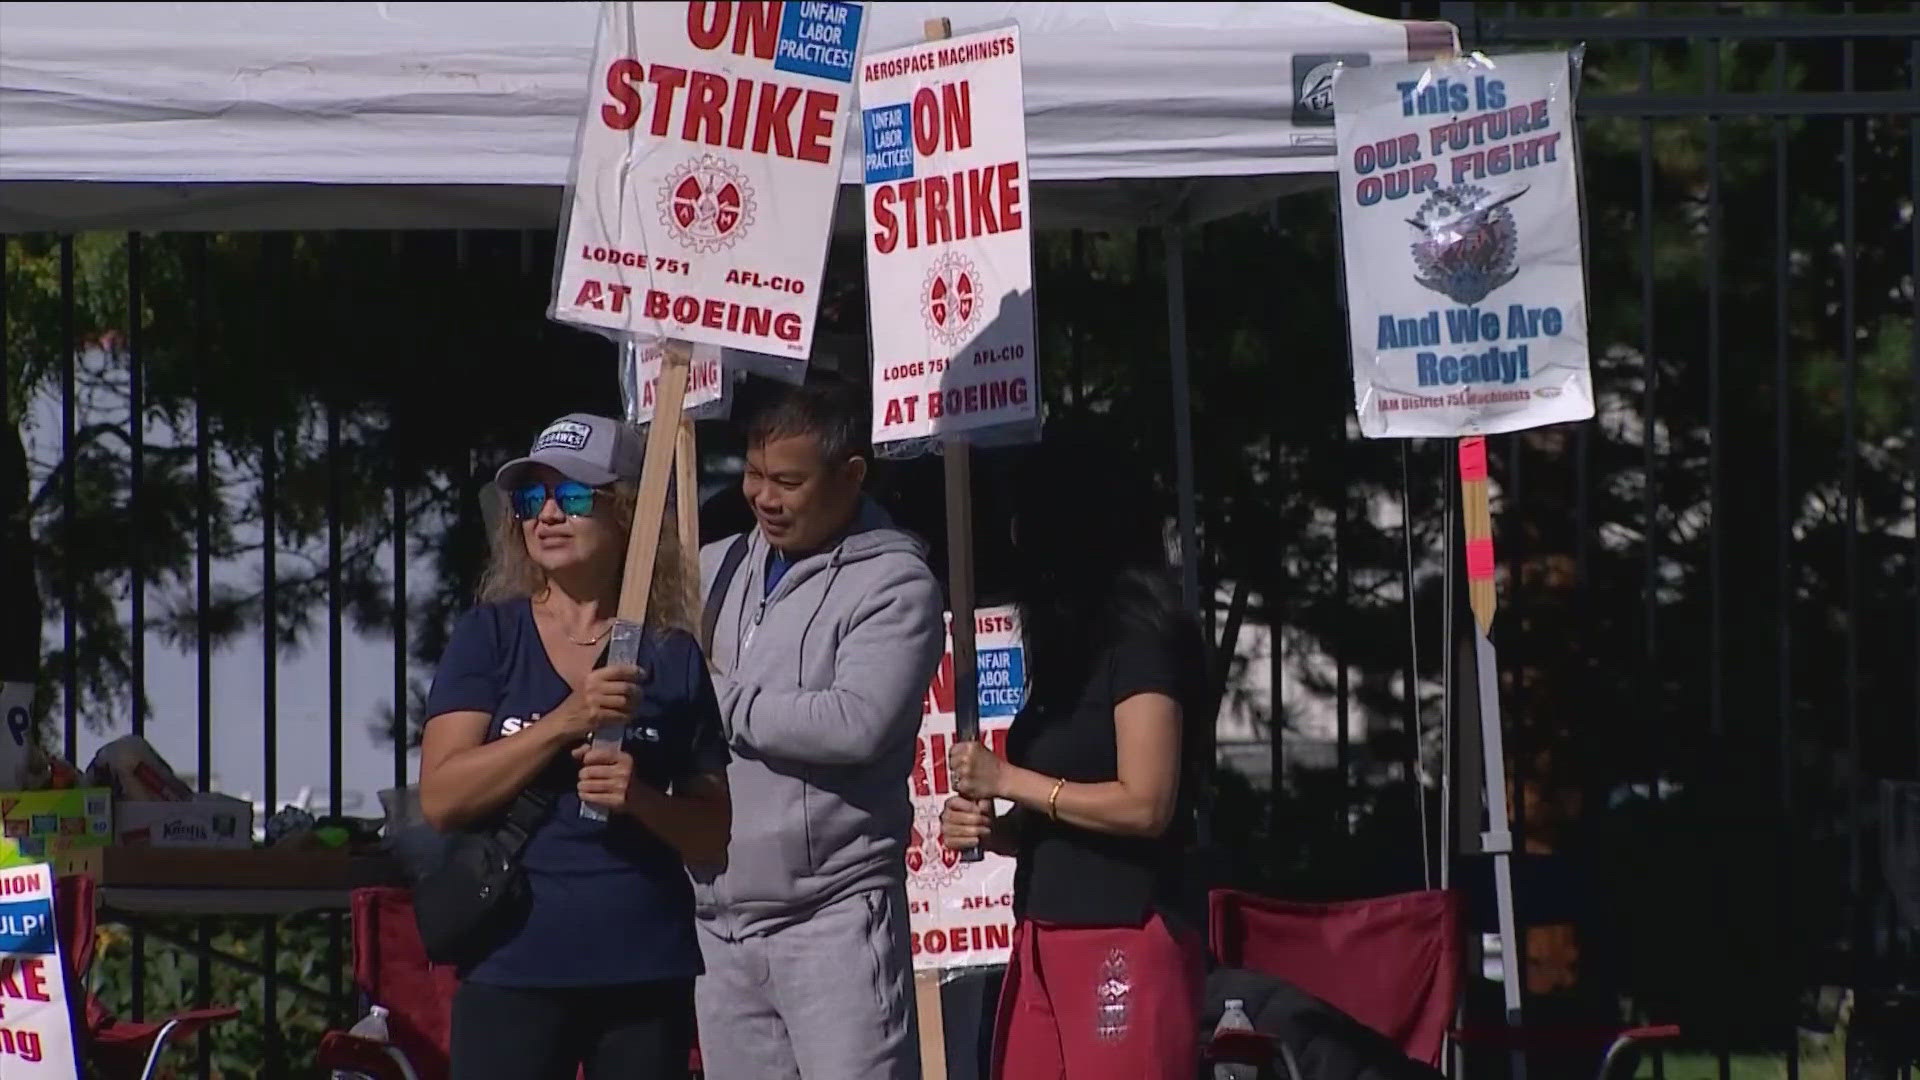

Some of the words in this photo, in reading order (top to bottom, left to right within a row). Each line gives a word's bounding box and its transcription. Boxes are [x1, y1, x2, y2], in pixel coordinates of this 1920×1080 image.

[800, 2, 848, 24] UNFAIR
[687, 1, 783, 60] ON
[798, 20, 842, 45] LABOR
[779, 39, 852, 68] PRACTICES!
[865, 53, 935, 82] AEROSPACE
[938, 36, 1015, 68] MACHINISTS
[601, 58, 839, 164] STRIKE
[1397, 77, 1469, 117] This
[1475, 75, 1507, 111] Is
[872, 109, 903, 126] UNFAIR
[913, 80, 972, 157] ON
[875, 129, 903, 149] LABOR
[1354, 132, 1421, 175] OUR
[1430, 98, 1549, 156] FUTURE
[866, 149, 912, 171] PRACTICES!
[1356, 163, 1439, 207] OUR
[1451, 131, 1561, 184] FIGHT
[874, 161, 1022, 254] STRIKE
[582, 246, 648, 269] LODGE
[656, 257, 690, 276] 751
[726, 269, 805, 294] AFL-CIO
[575, 280, 631, 313] AT
[644, 290, 801, 342] BOEING
[1377, 311, 1441, 350] And
[1446, 307, 1500, 344] We
[1507, 304, 1562, 340] Are
[884, 361, 924, 382] LODGE
[928, 357, 950, 375] 751
[973, 345, 1024, 367] AFL-CIO
[1416, 344, 1529, 387] Ready!
[687, 359, 718, 392] ING
[884, 394, 919, 427] AT
[928, 377, 1028, 421] BOEING
[975, 617, 1013, 634] ISTS
[977, 653, 1011, 669] NFAIR
[978, 670, 1010, 686] ABOR
[0, 873, 40, 896] ION
[911, 902, 930, 914] 51
[962, 895, 1012, 909] AFL-C
[911, 924, 1010, 955] OEIN
